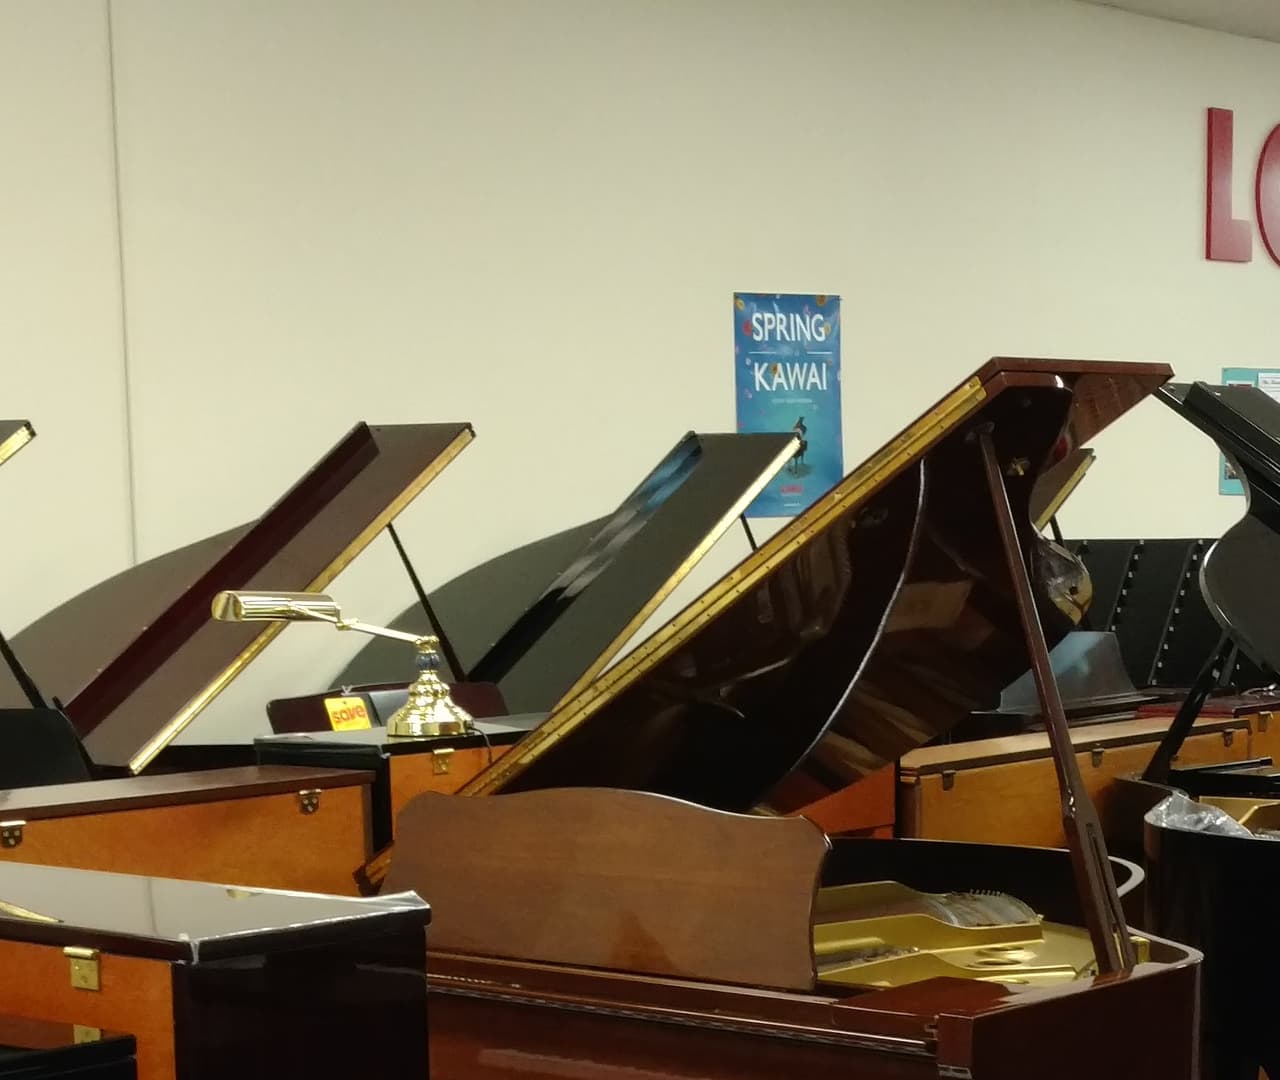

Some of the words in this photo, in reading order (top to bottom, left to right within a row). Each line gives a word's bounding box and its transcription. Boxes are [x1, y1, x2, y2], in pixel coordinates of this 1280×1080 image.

[751, 311, 826, 342] SPRING
[754, 362, 828, 392] KAWAI
[331, 705, 366, 724] save
